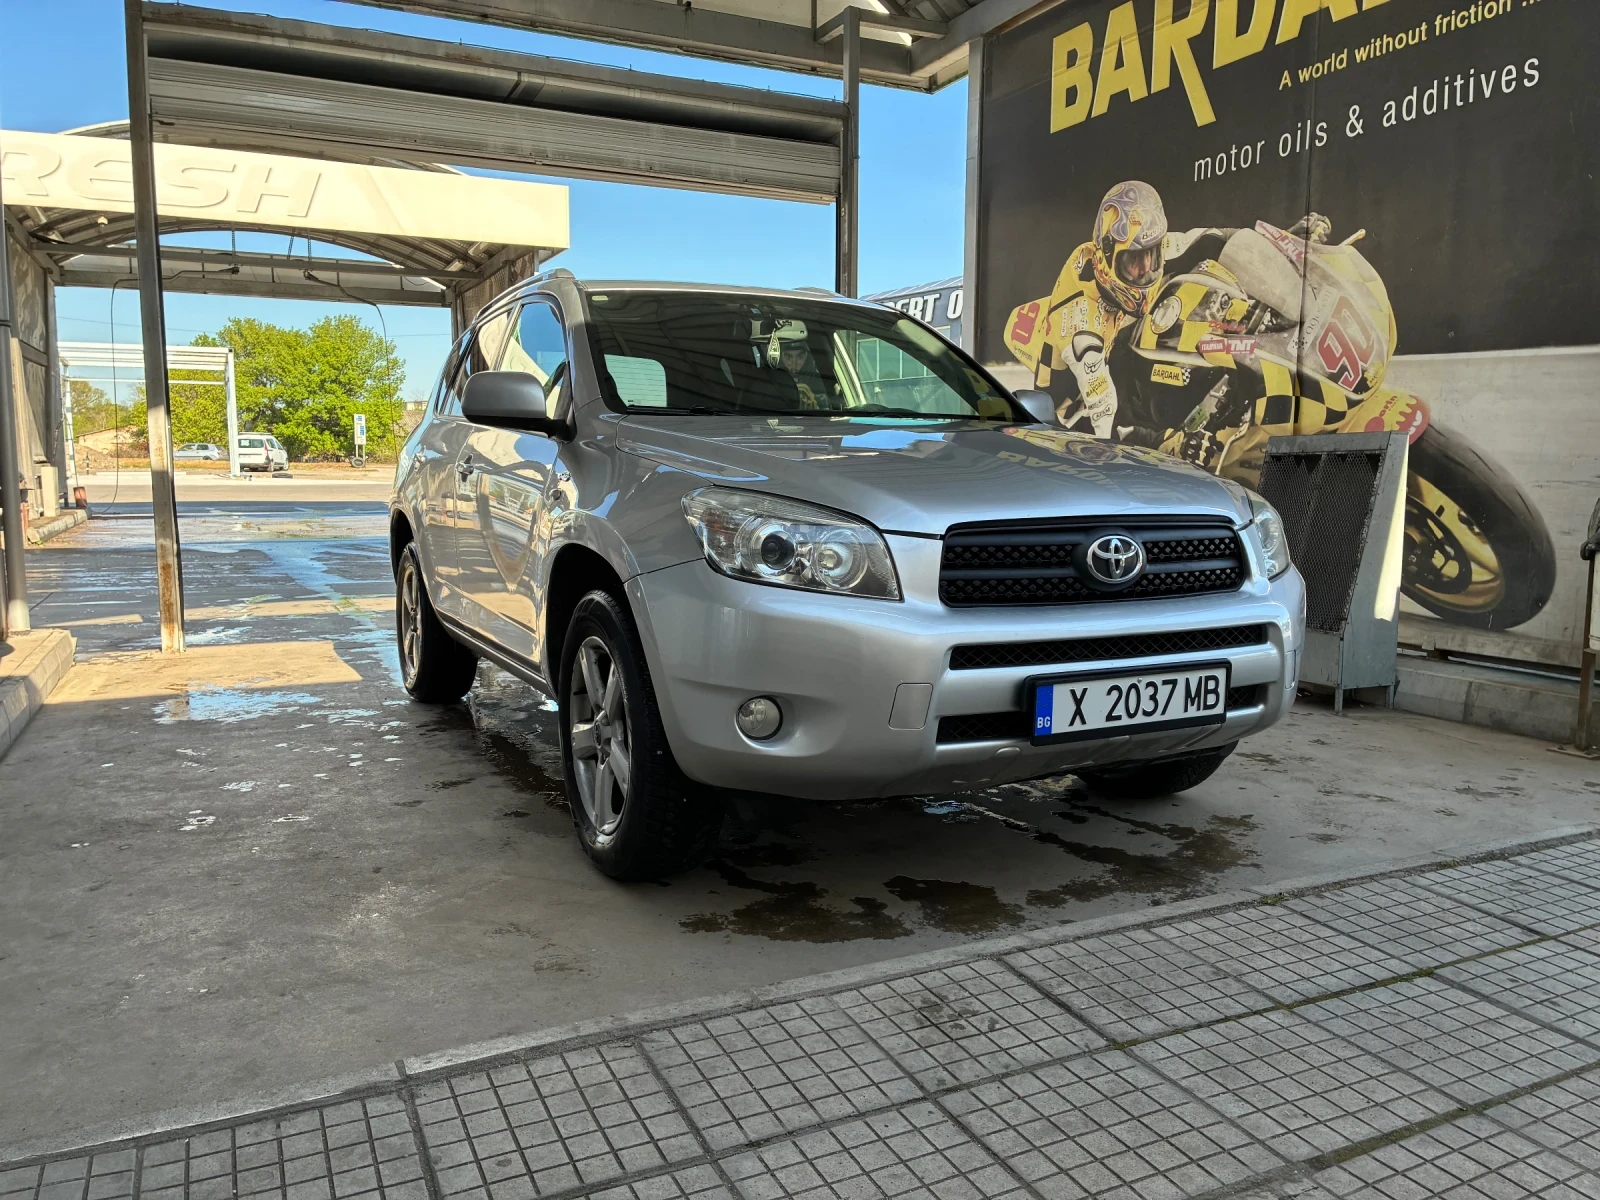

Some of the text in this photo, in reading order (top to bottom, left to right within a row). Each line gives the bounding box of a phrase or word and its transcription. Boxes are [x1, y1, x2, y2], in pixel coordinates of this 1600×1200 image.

[1278, 69, 1292, 90] A
[1298, 48, 1348, 84] world
[1354, 21, 1428, 63] without
[1434, 0, 1512, 36] friction
[1194, 57, 1541, 181] motor oils & additives
[1227, 339, 1256, 351] TNT
[1152, 369, 1180, 382] BARDAHL
[1036, 675, 1221, 729] BG X 2037 MB
